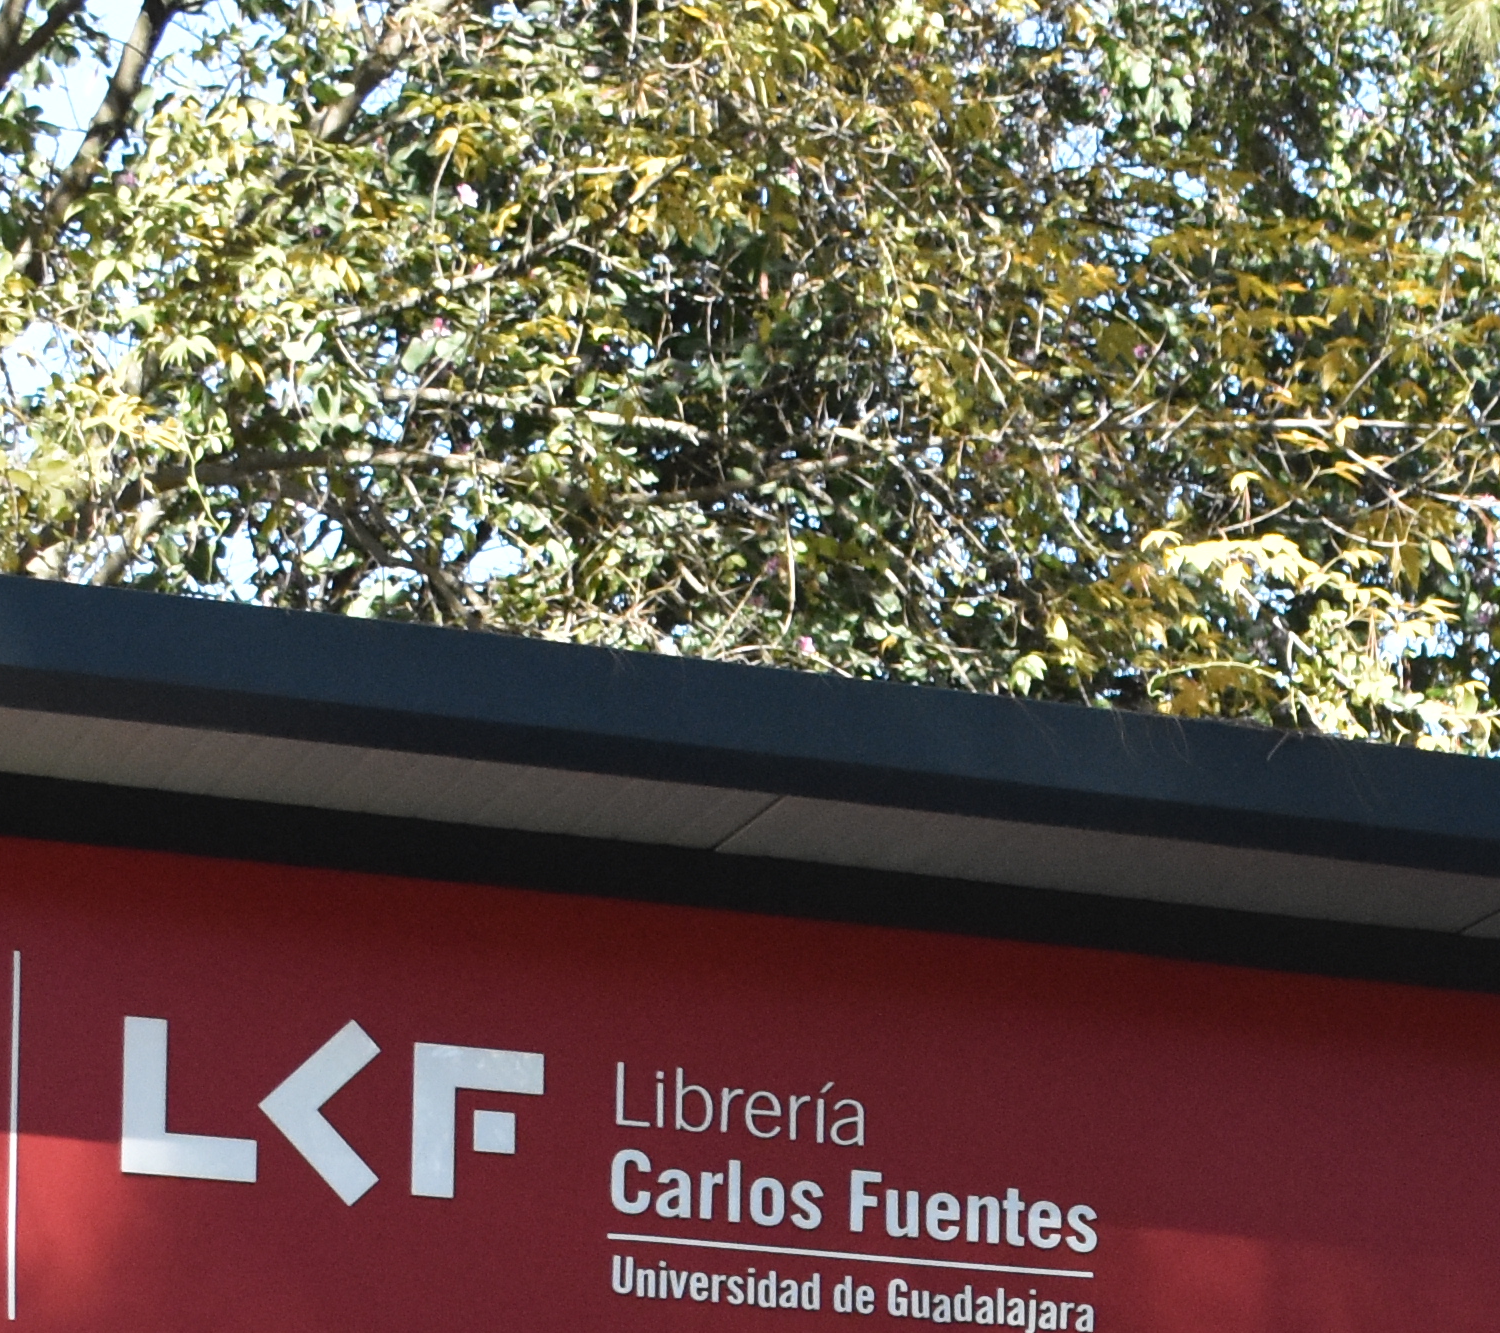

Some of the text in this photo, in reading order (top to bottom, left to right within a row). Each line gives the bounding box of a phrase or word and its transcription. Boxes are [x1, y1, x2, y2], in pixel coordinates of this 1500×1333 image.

[614, 1061, 866, 1146] Librería
[609, 1148, 1098, 1254] Carlos Fuentes
[611, 1254, 821, 1311] Universidad
[832, 1275, 876, 1315] de
